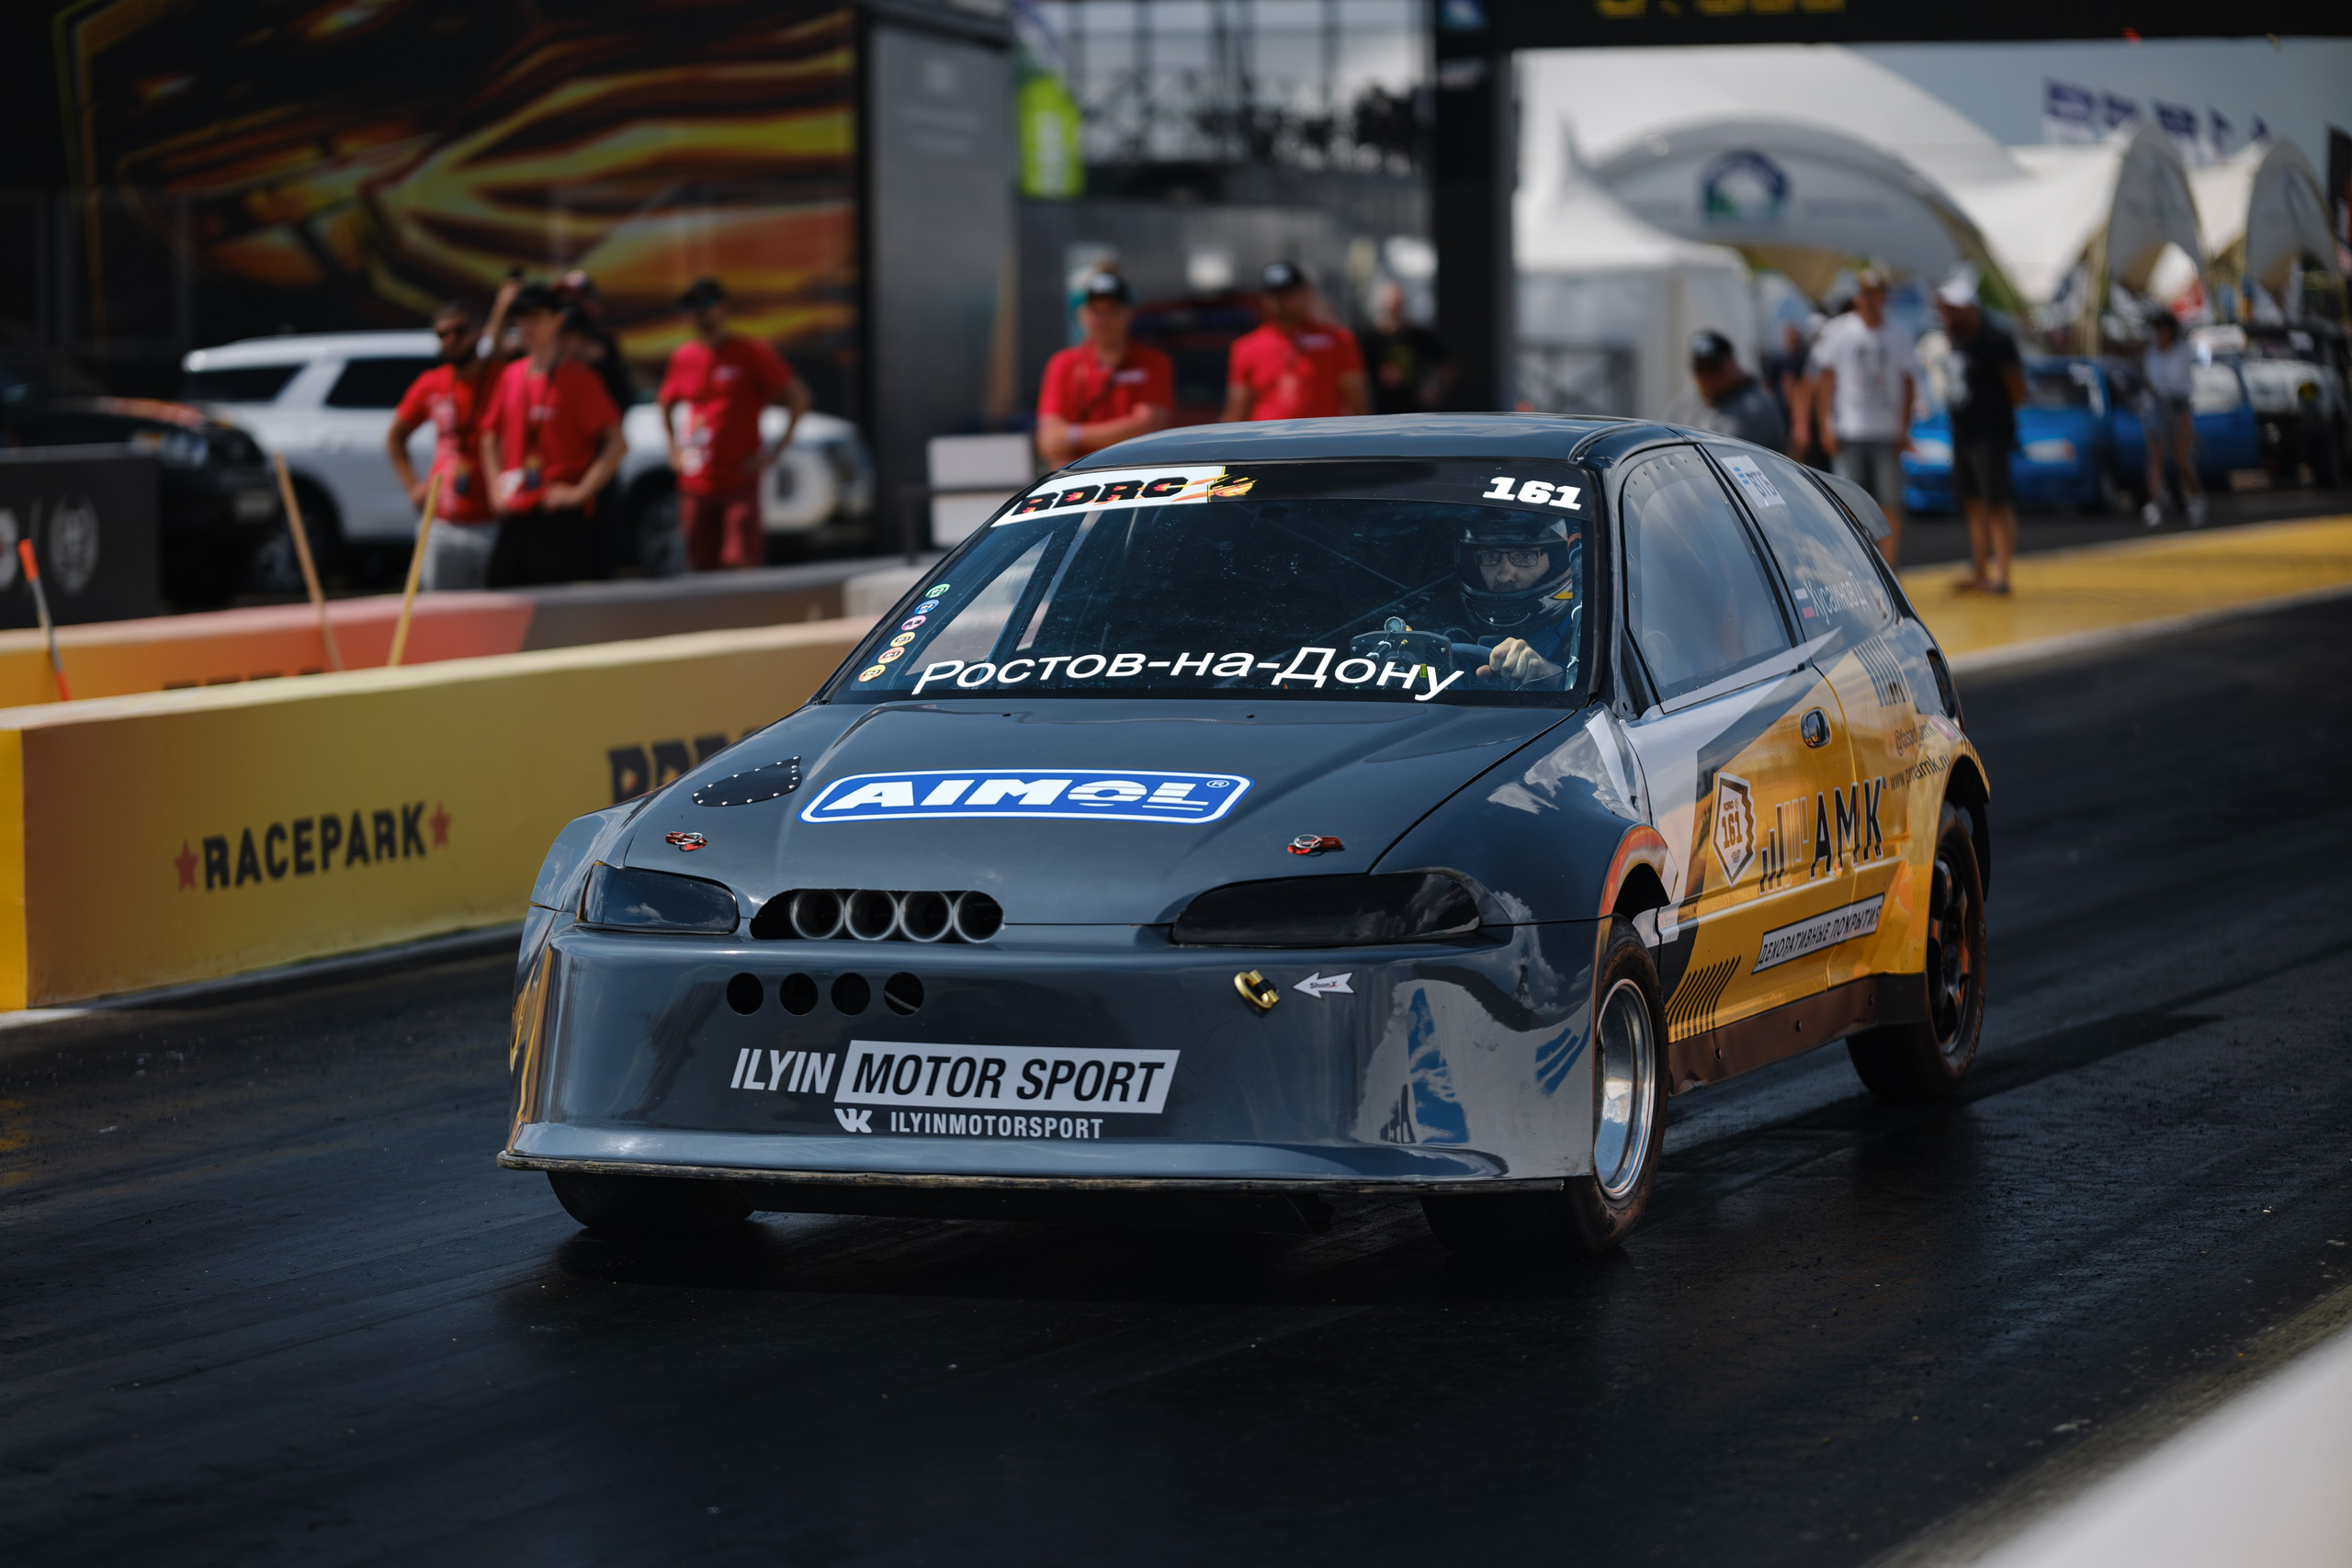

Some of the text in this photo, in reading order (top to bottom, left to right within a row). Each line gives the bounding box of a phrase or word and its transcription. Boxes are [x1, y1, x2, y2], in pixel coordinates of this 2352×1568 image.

[1011, 476, 1188, 516] RDRC
[1482, 477, 1581, 510] 161
[911, 646, 1464, 702] Ростов-на-Дону
[203, 801, 426, 892] RACEPARK
[1722, 810, 1743, 849] 161
[1758, 904, 1882, 966] ДЕКОРАТИВНЫЕ ПОКРЫТИЯ
[730, 1048, 1166, 1103] ILYIN MOTOR SPORT
[890, 1111, 1103, 1139] ILYINMOTORSPORT
